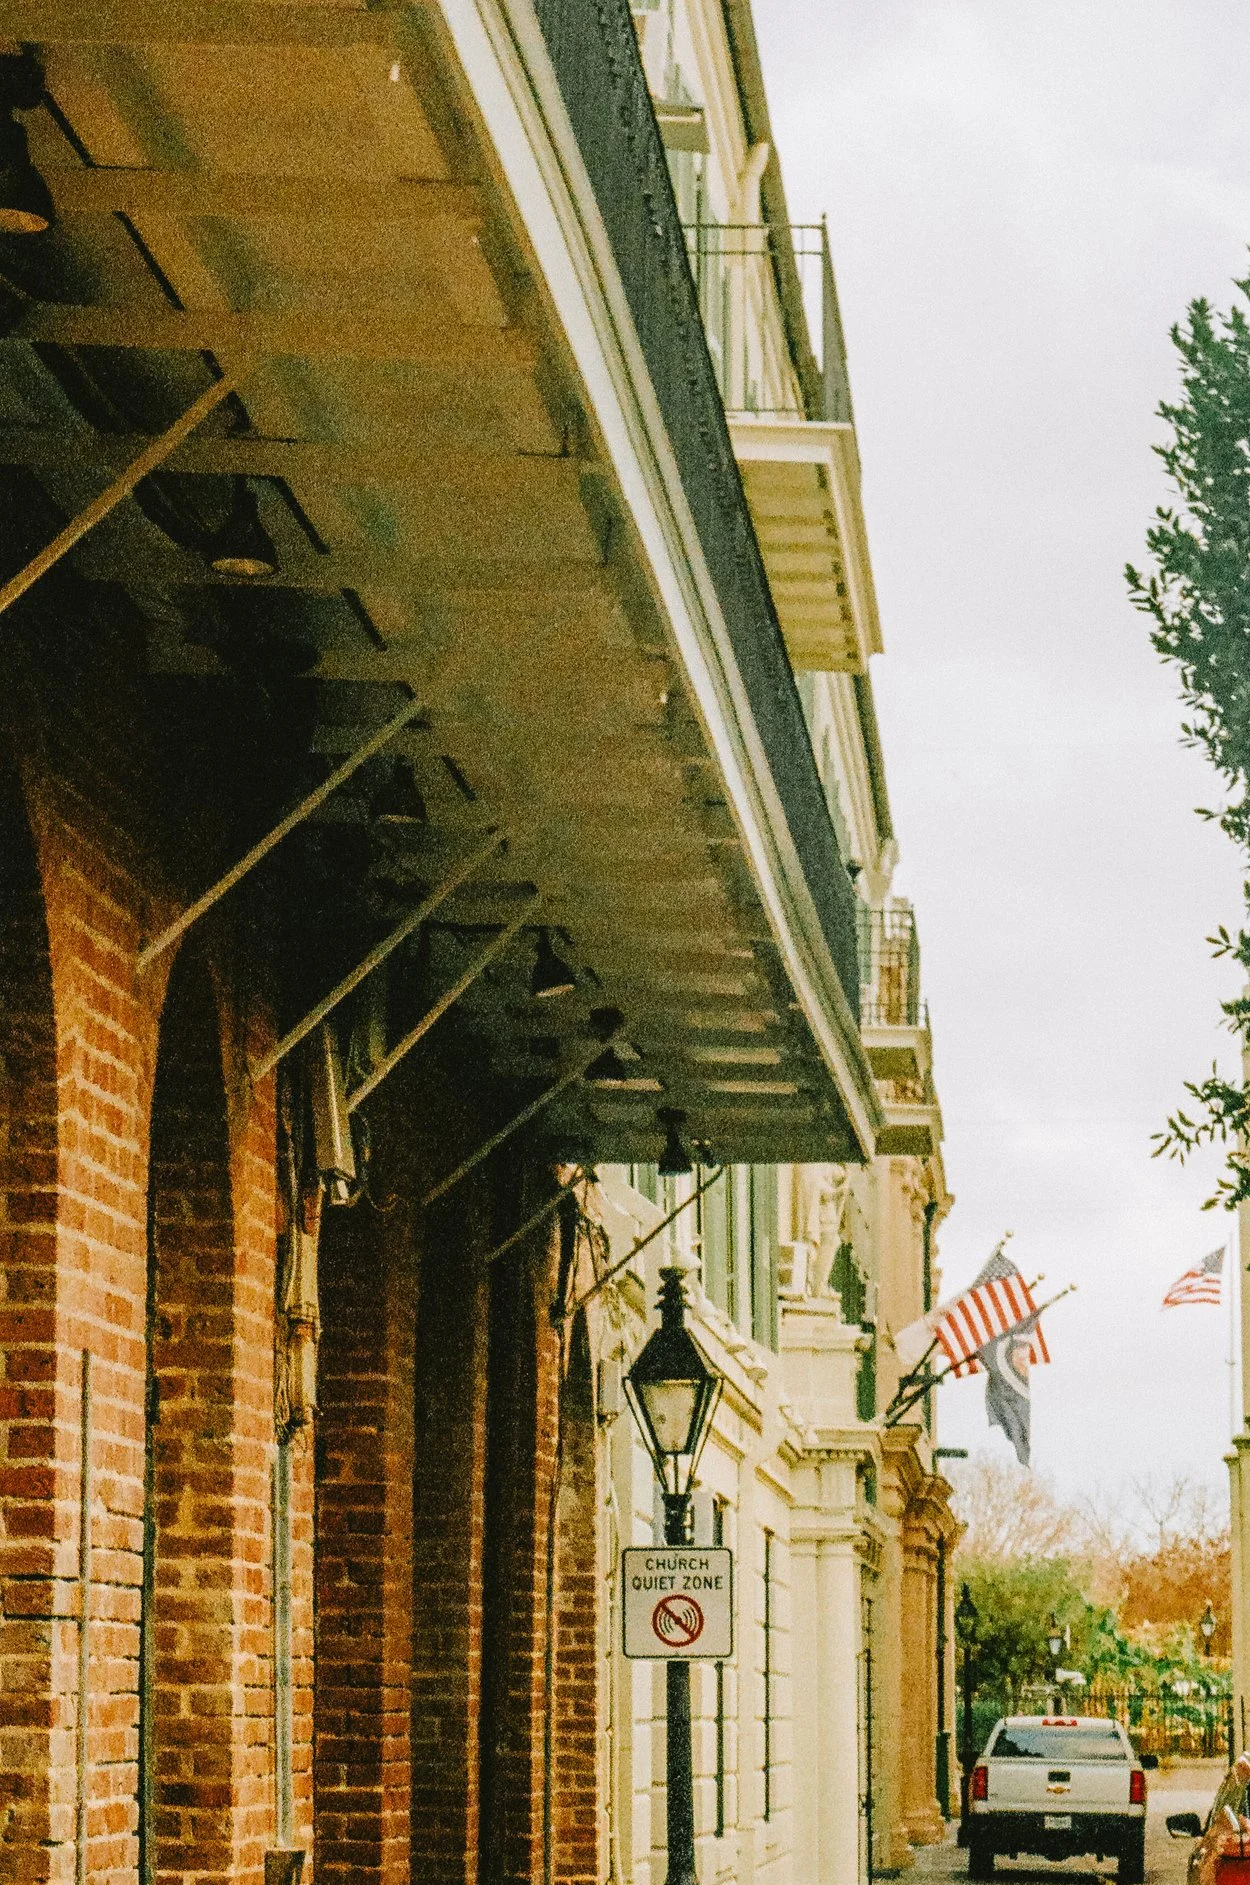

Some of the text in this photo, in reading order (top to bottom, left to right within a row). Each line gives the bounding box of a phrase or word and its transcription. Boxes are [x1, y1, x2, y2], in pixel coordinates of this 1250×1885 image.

[645, 1558, 709, 1571] CHURCH
[631, 1576, 723, 1591] QUIET ZONE
